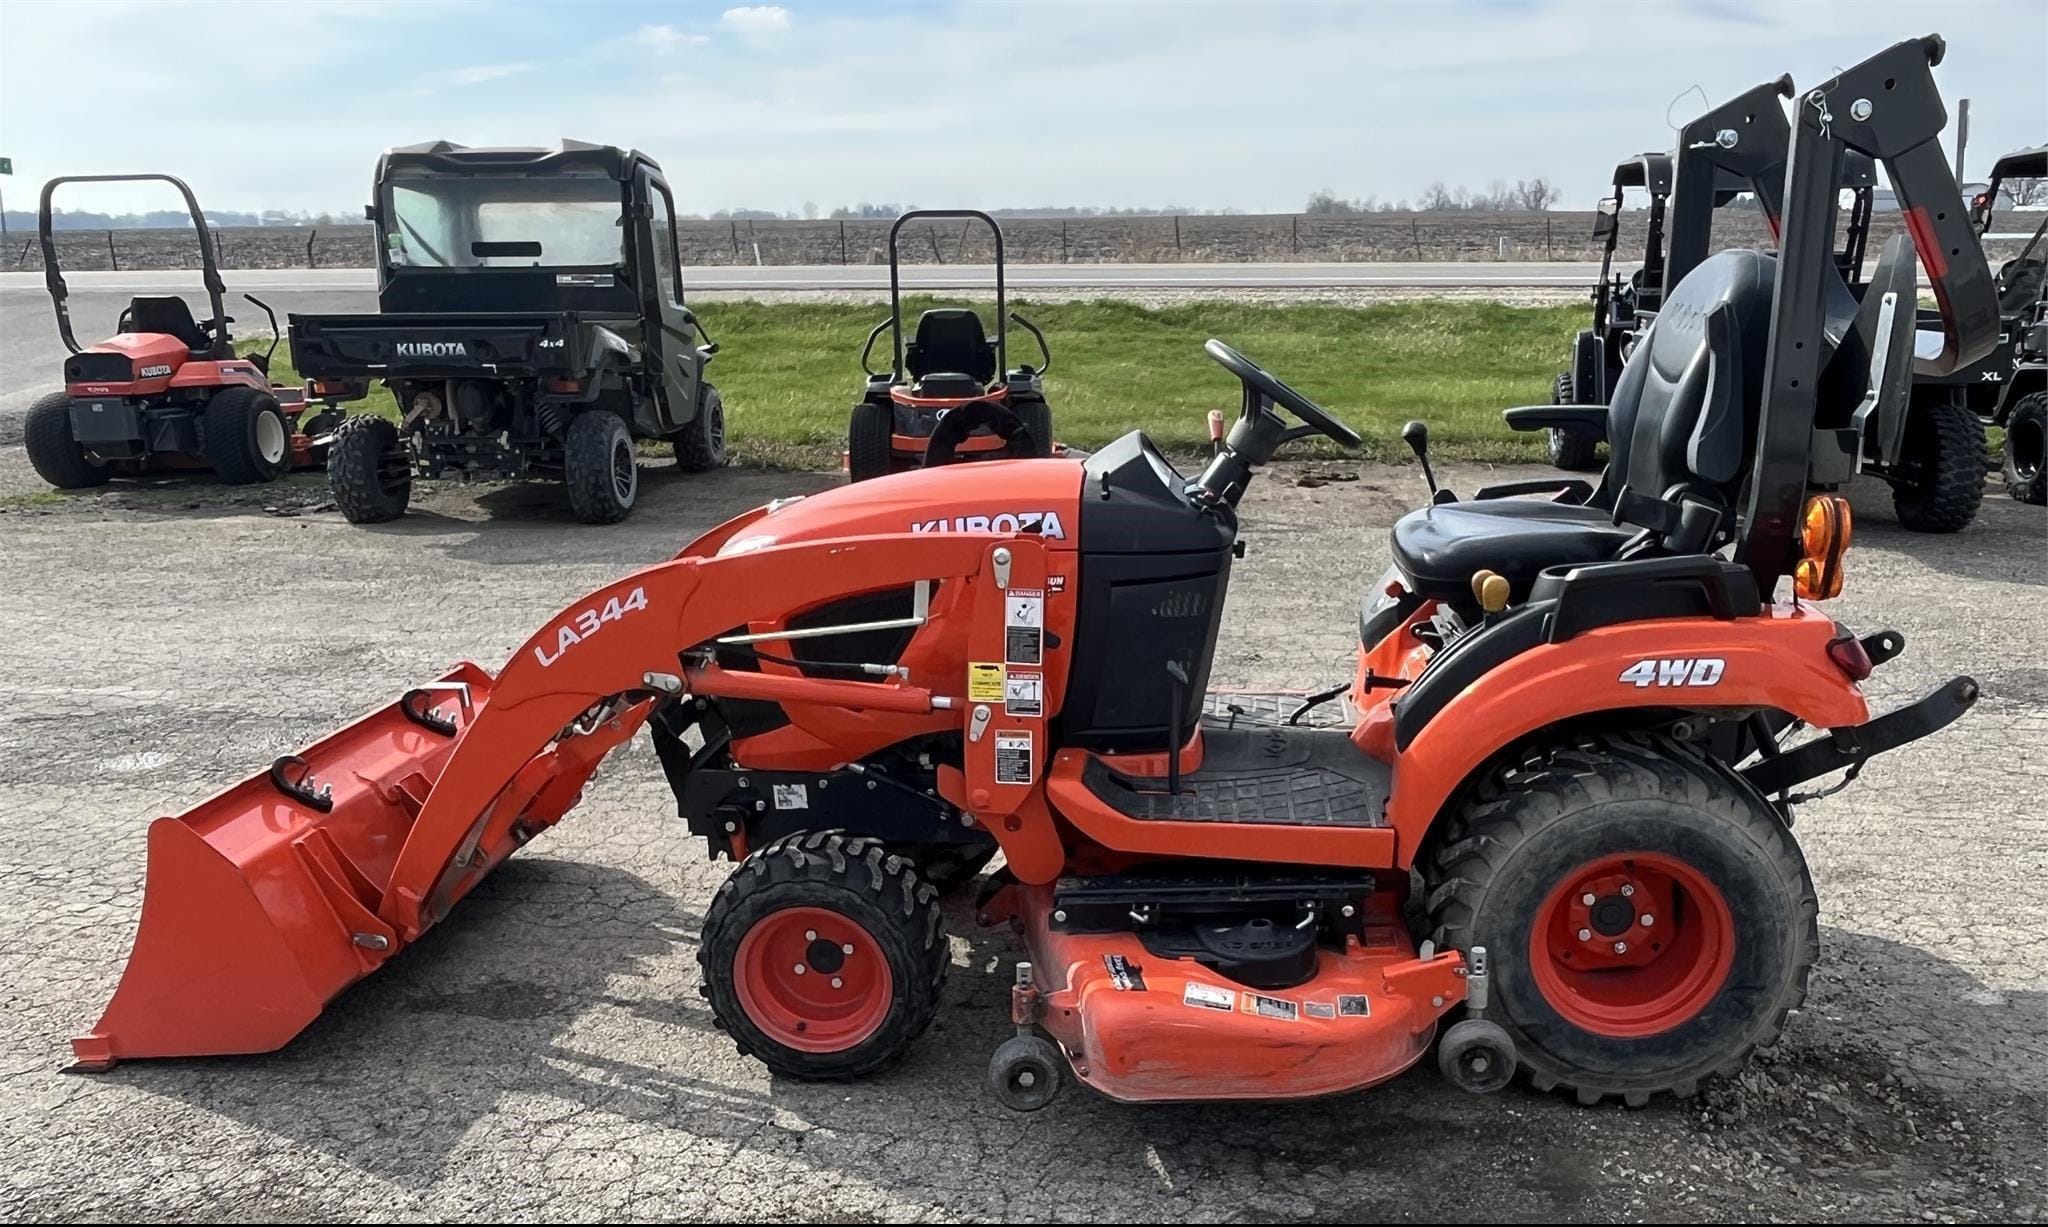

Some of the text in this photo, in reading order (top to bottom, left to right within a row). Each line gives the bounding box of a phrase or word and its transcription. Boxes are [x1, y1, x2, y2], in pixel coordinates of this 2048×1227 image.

[396, 343, 467, 356] KUBOTA
[539, 339, 564, 348] 4x4
[141, 365, 171, 377] KUBOTA
[1981, 371, 2002, 381] XL
[534, 586, 649, 667] LA344
[1618, 658, 1726, 687] 4WD
